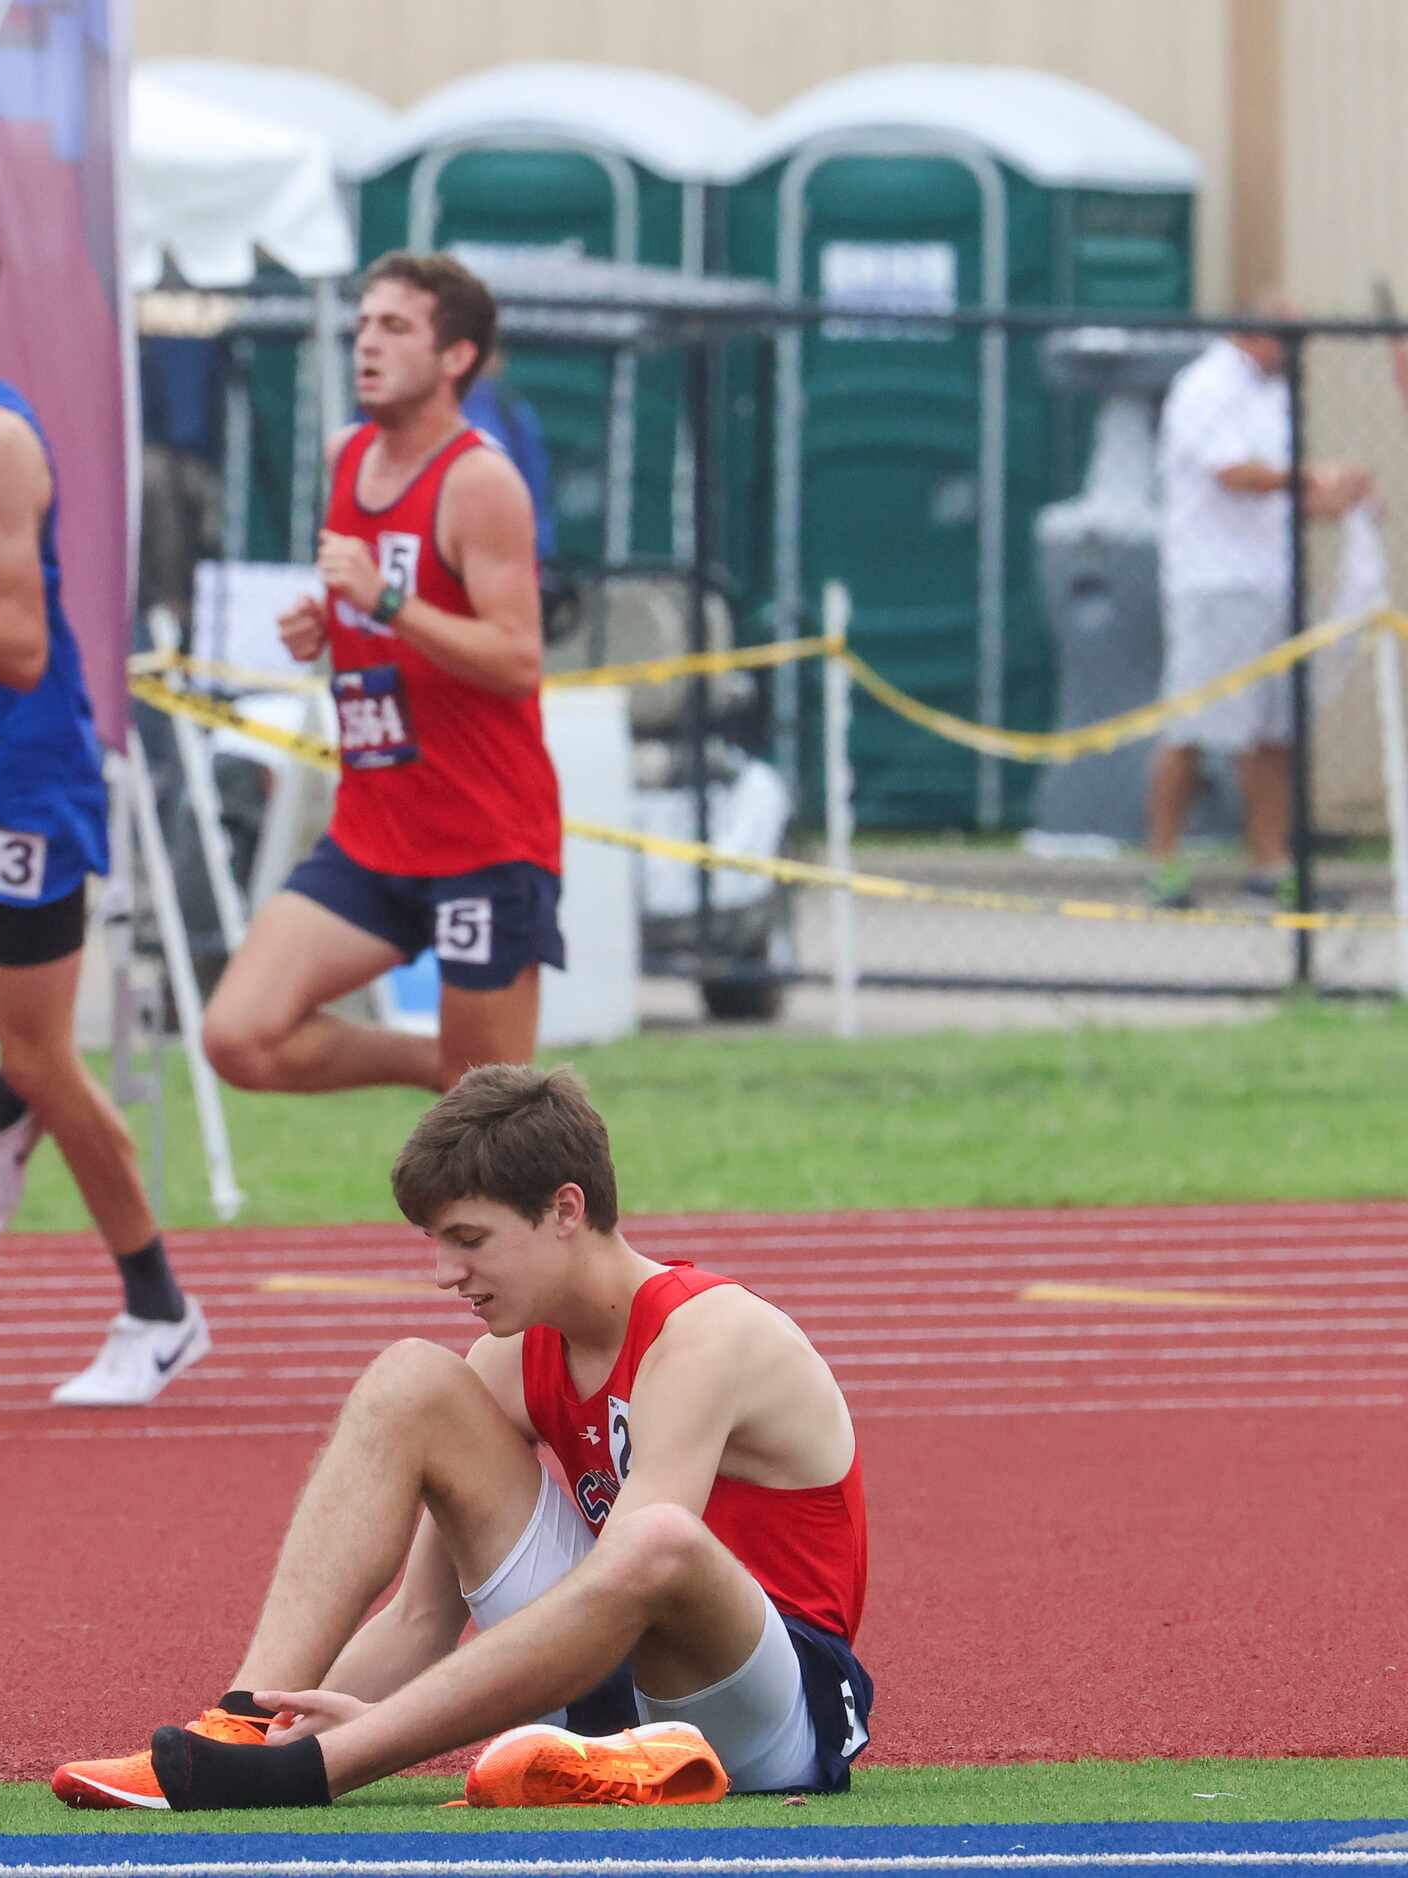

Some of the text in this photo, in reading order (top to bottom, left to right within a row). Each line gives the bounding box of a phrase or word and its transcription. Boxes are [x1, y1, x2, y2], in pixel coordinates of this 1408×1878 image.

[391, 546, 408, 594] 5
[0, 841, 33, 886] 3
[448, 908, 479, 949] 5
